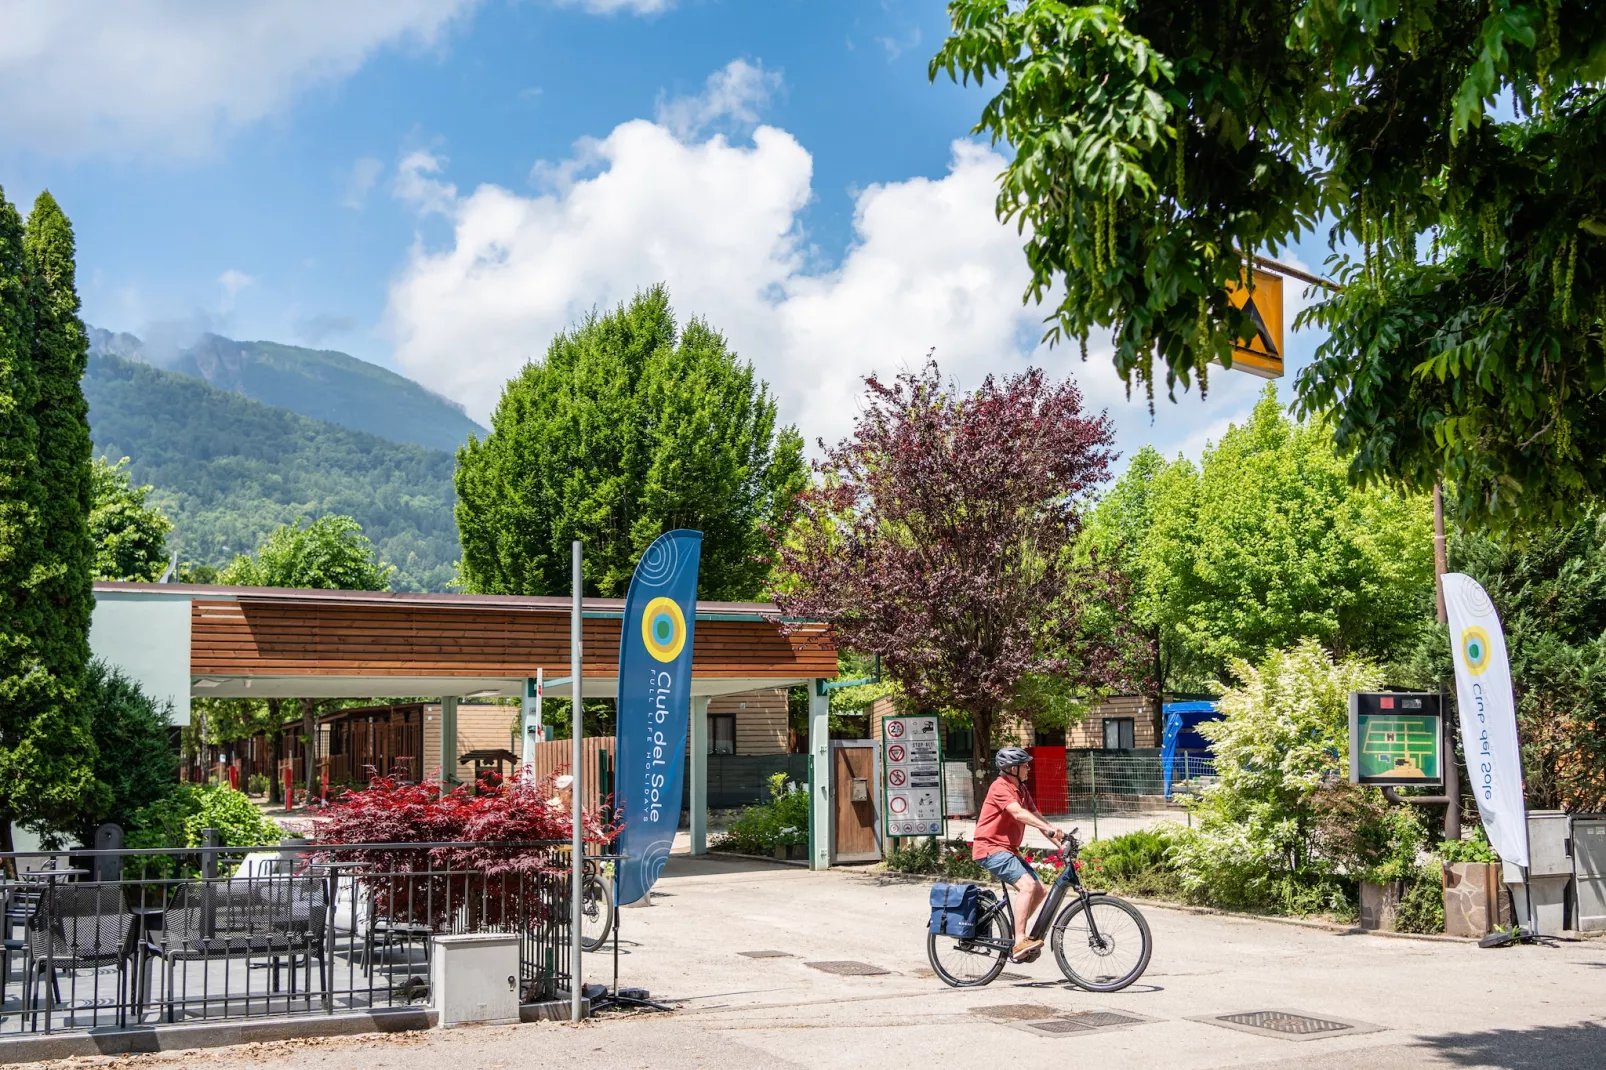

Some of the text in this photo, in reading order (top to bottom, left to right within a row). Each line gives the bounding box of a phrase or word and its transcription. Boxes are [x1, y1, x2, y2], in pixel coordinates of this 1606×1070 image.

[643, 752, 651, 822] HOLIDAYS
[650, 671, 671, 823] Club del Sole
